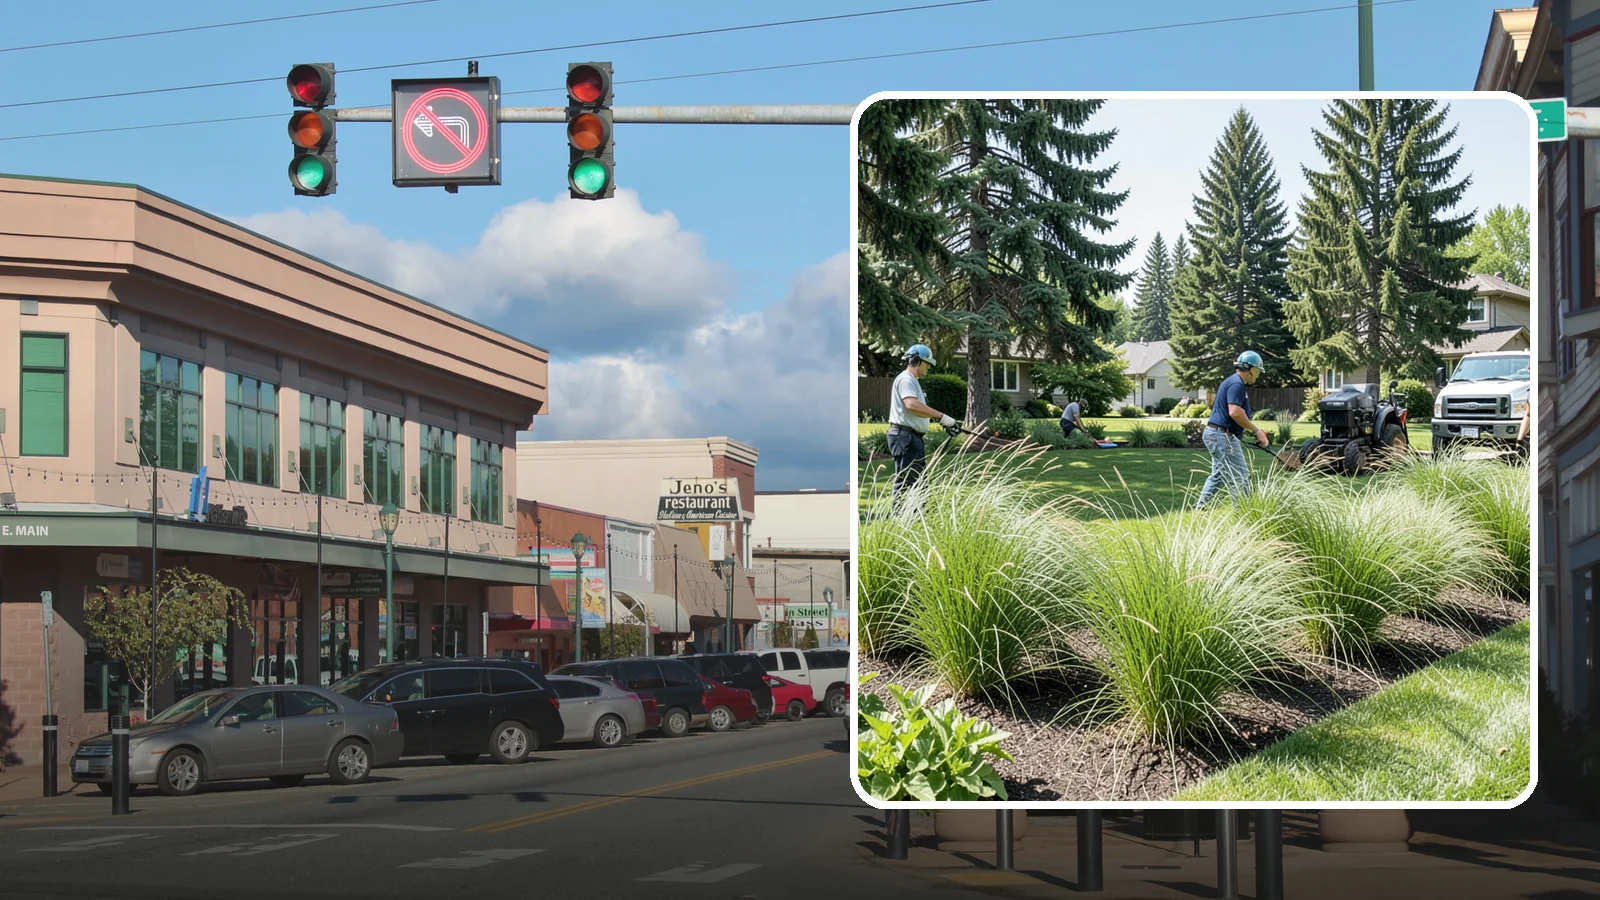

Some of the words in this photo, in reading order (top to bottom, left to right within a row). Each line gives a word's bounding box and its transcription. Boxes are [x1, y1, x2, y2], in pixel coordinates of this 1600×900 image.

[669, 480, 728, 495] Jeno's
[665, 496, 731, 509] restaurant
[658, 510, 682, 520] Italian
[686, 510, 715, 519] American
[715, 509, 738, 520] Cuisine
[2, 525, 13, 536] E.
[15, 525, 49, 536] MAIN
[797, 607, 828, 616] Street
[791, 619, 823, 627] lass
